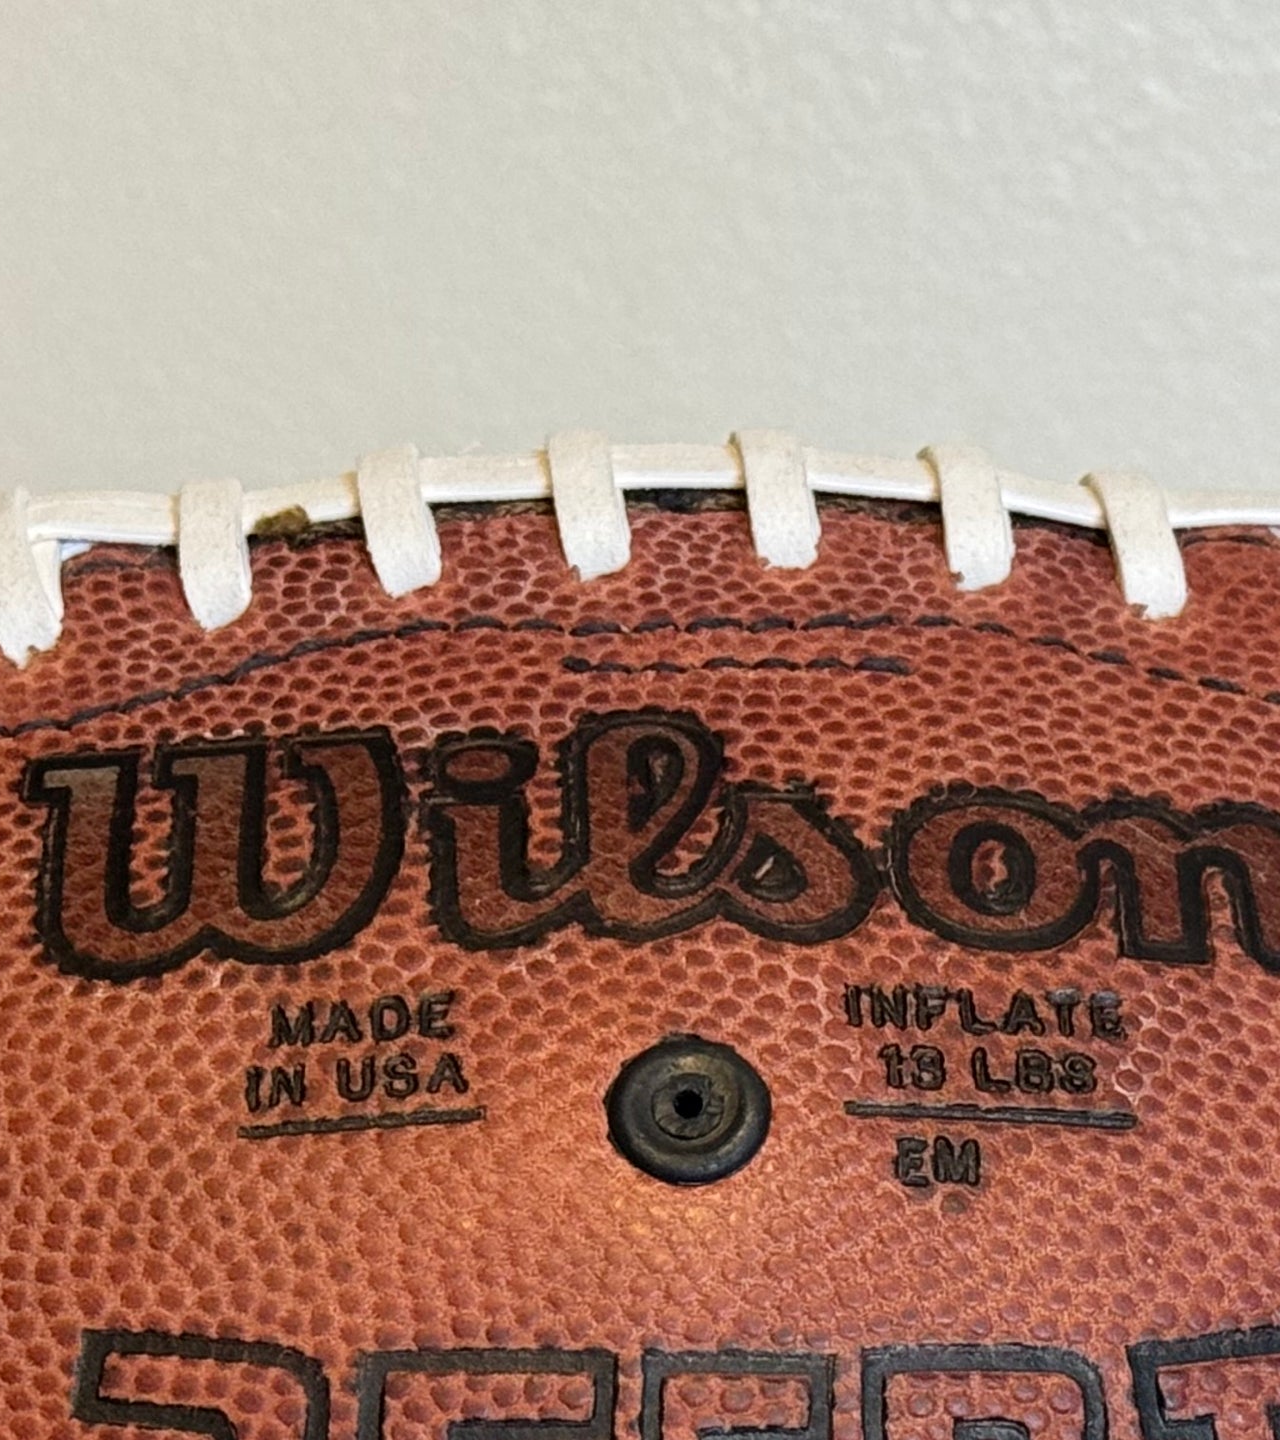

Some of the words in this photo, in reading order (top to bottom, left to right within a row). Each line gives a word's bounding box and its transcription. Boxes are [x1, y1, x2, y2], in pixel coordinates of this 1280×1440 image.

[268, 989, 456, 1048] MADE
[842, 983, 1128, 1040] INFLATE
[244, 1062, 306, 1112] IN
[335, 1053, 469, 1100] USA
[879, 1044, 946, 1090] 13
[971, 1046, 1098, 1094] LBS
[893, 1136, 980, 1186] EM
